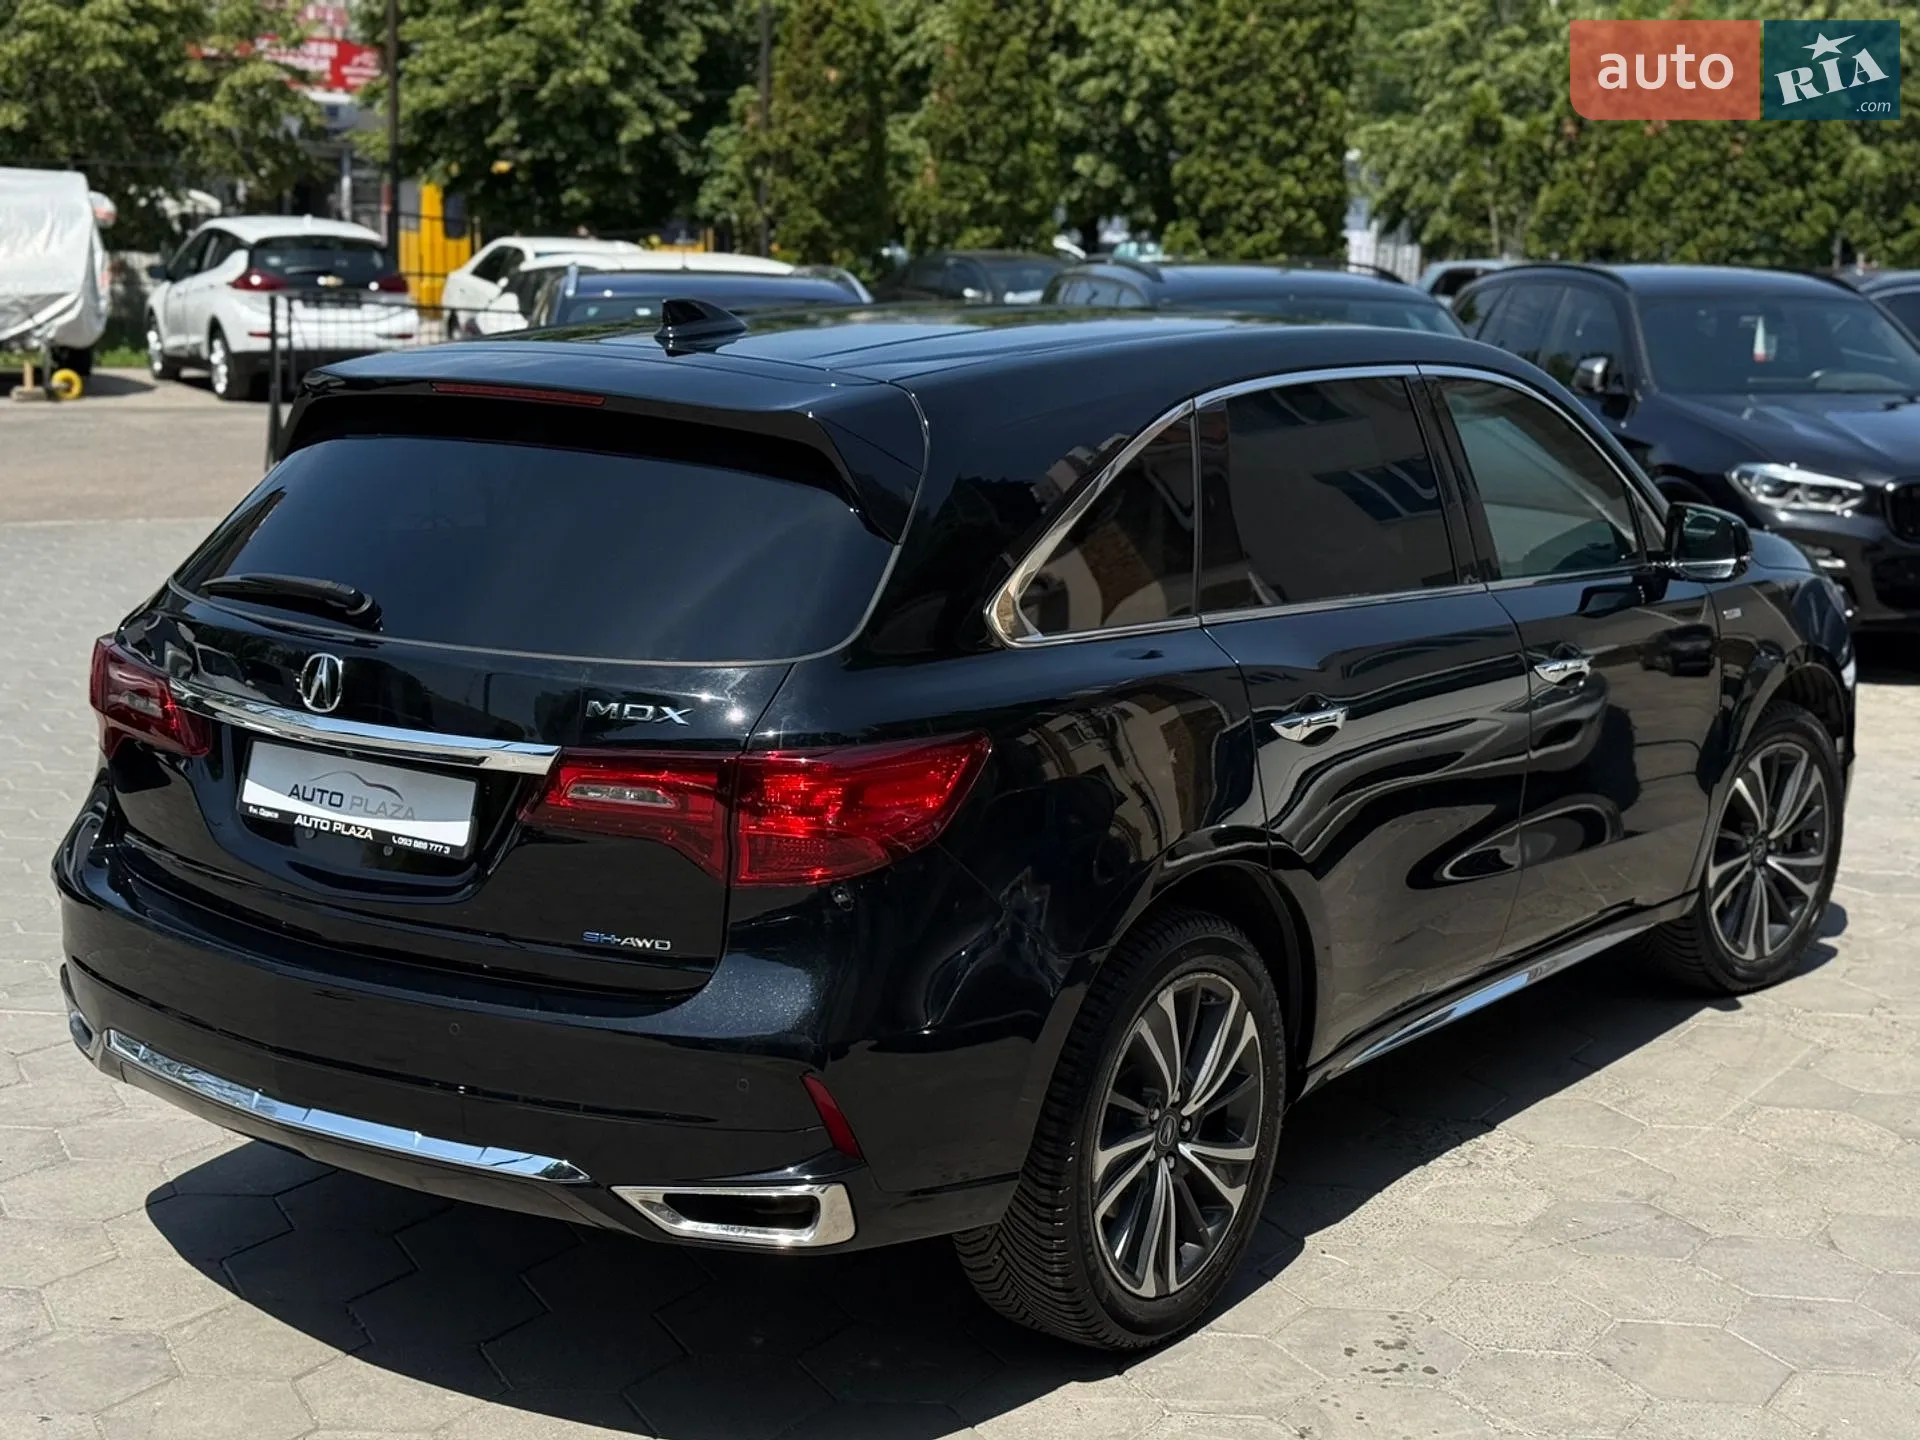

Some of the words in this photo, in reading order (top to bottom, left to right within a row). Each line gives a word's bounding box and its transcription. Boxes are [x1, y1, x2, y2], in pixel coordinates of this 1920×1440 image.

[585, 700, 694, 727] MDX
[288, 783, 344, 808] AUTO
[349, 795, 416, 821] PLAZA
[294, 815, 330, 831] AUTO
[332, 821, 374, 840] PLAZA
[583, 931, 671, 951] SH-AWD
